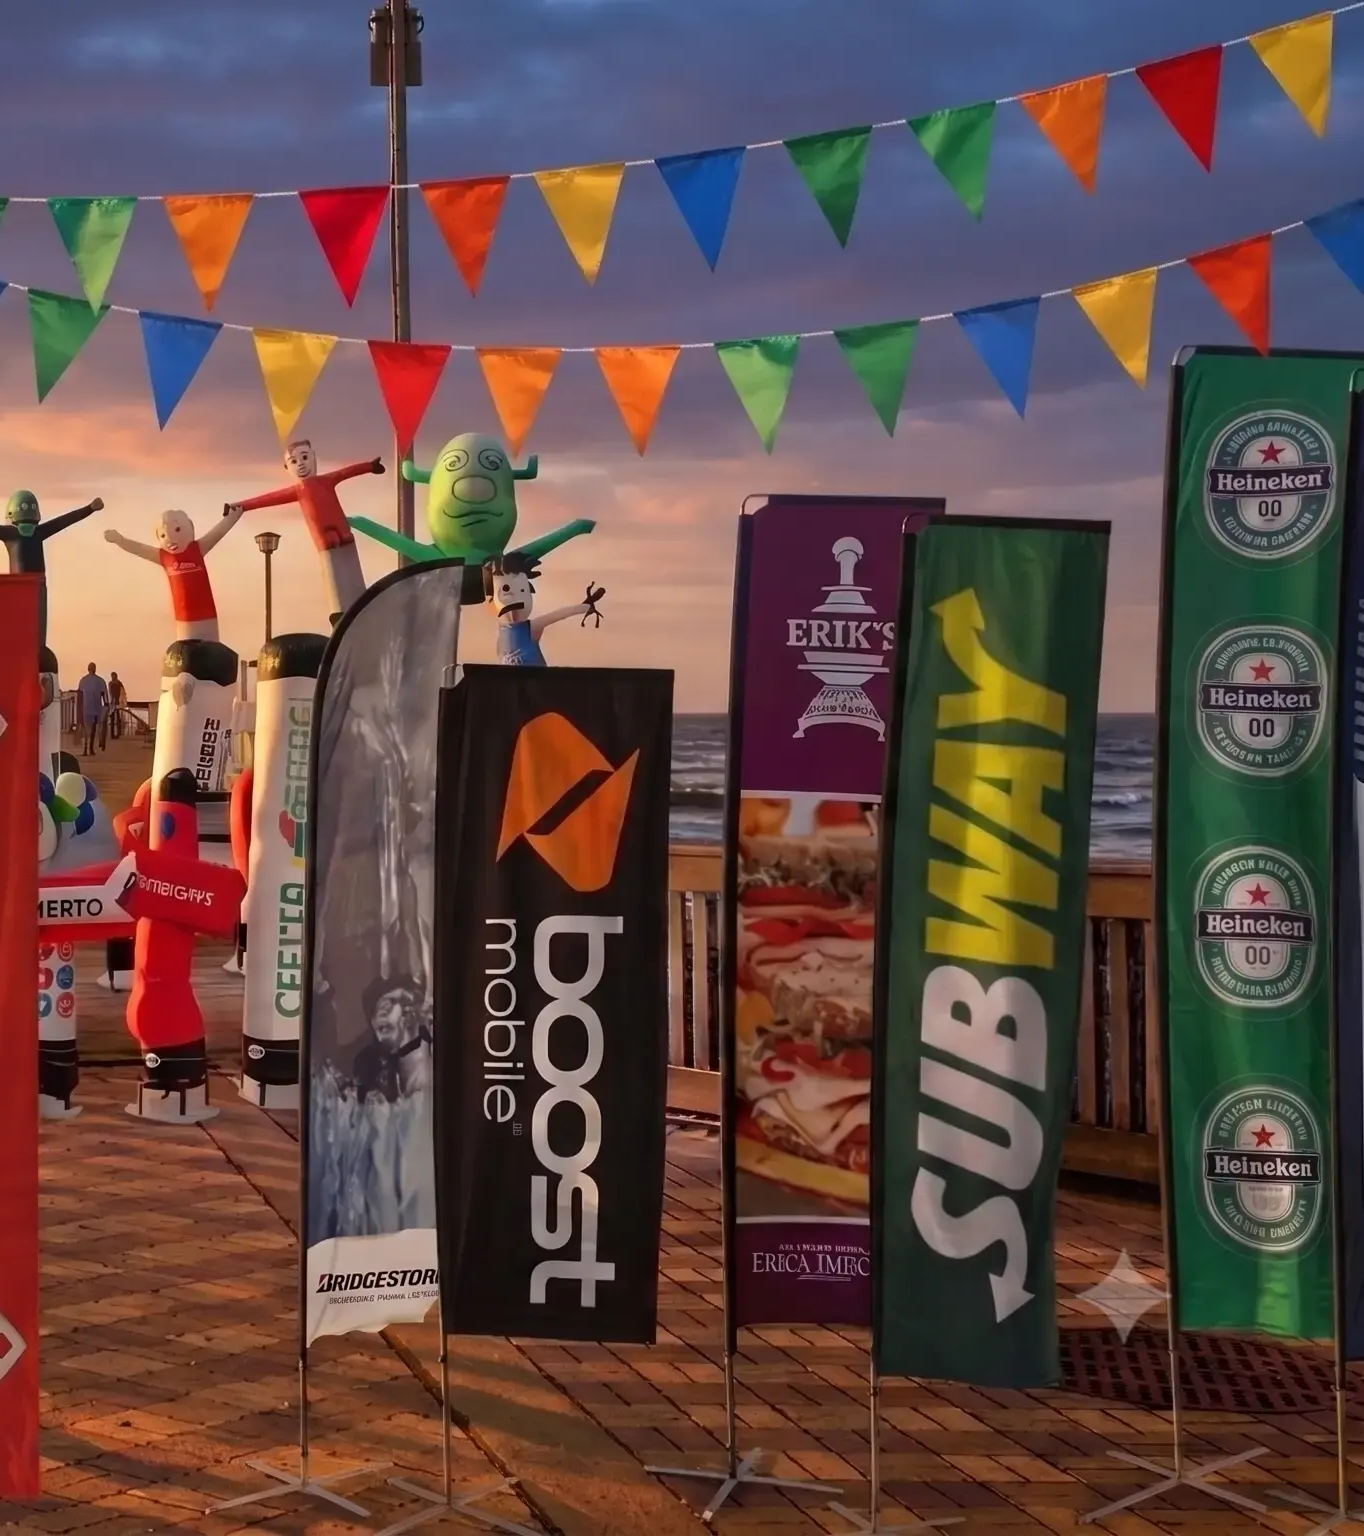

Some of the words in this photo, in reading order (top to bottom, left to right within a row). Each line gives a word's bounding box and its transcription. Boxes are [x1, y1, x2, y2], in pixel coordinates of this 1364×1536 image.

[1217, 472, 1323, 491] Heineken
[1209, 687, 1312, 708] Heineken
[1206, 914, 1305, 937] Heineken
[911, 588, 1067, 1324] SUBWAY
[483, 917, 525, 1123] mobile
[529, 916, 624, 1308] boost
[1214, 1155, 1313, 1177] Heineken
[316, 1269, 438, 1293] BRIDGESTOR
